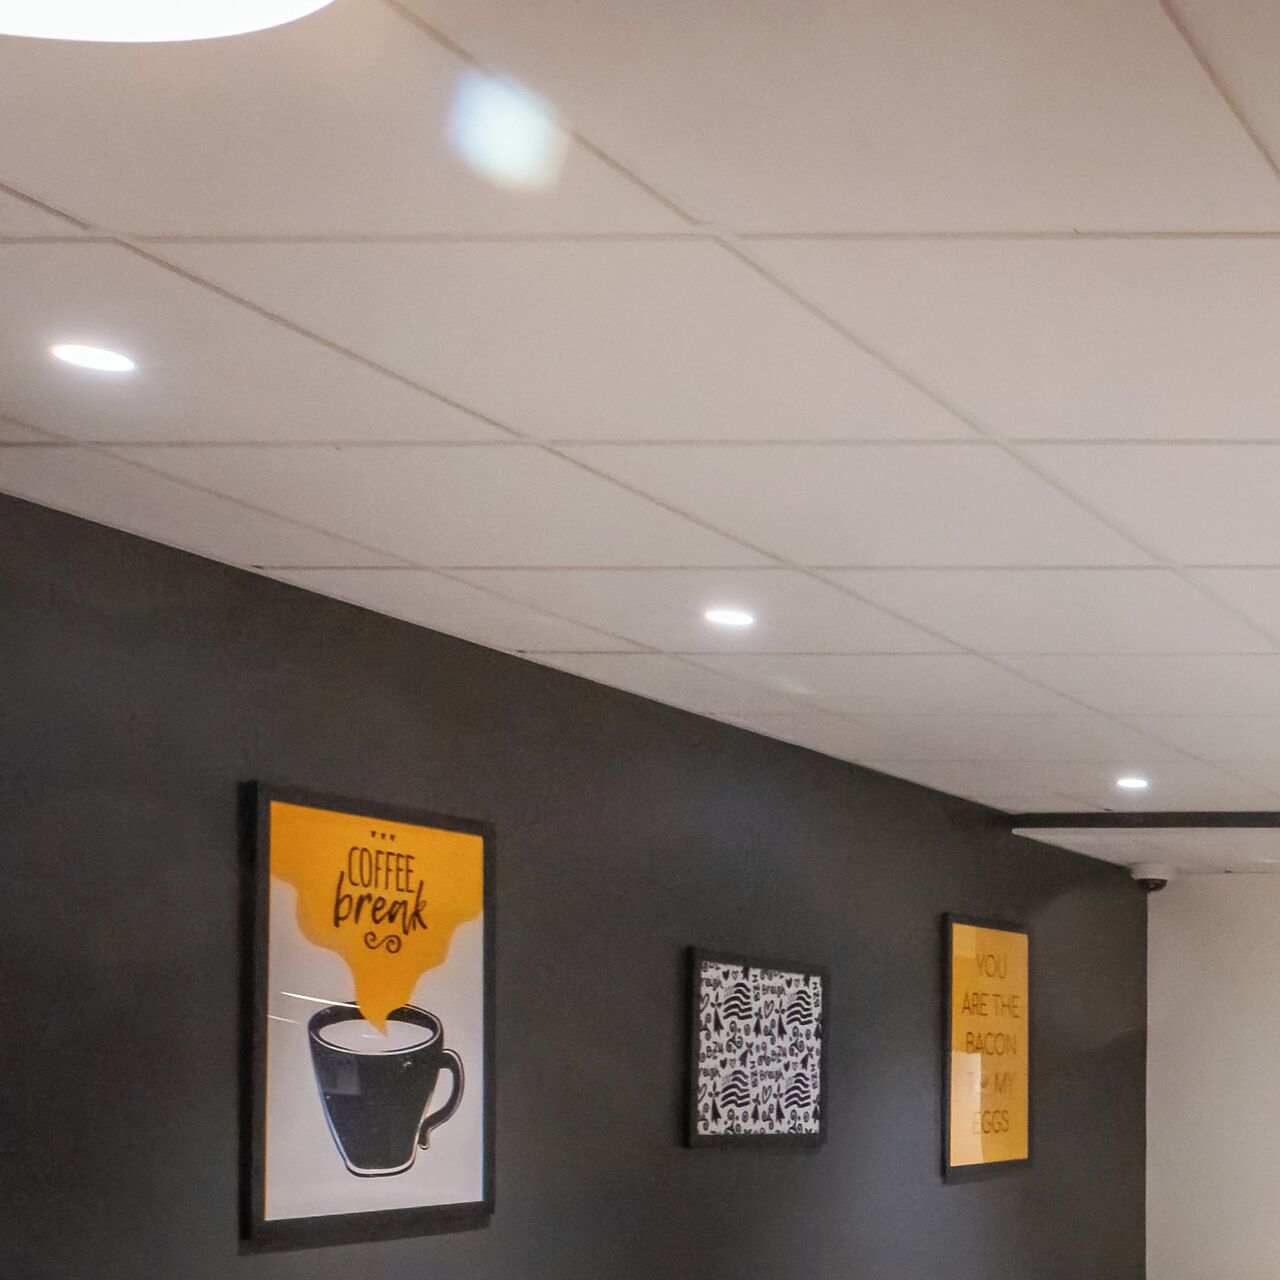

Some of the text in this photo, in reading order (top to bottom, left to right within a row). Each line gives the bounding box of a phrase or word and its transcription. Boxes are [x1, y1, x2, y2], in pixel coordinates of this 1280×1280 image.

[348, 846, 415, 893] COFFEE
[333, 870, 428, 935] break
[976, 953, 1008, 979] YOU
[961, 991, 1020, 1018] ARE THE
[966, 1031, 1018, 1056] BACON
[972, 1109, 1010, 1135] EGGS
